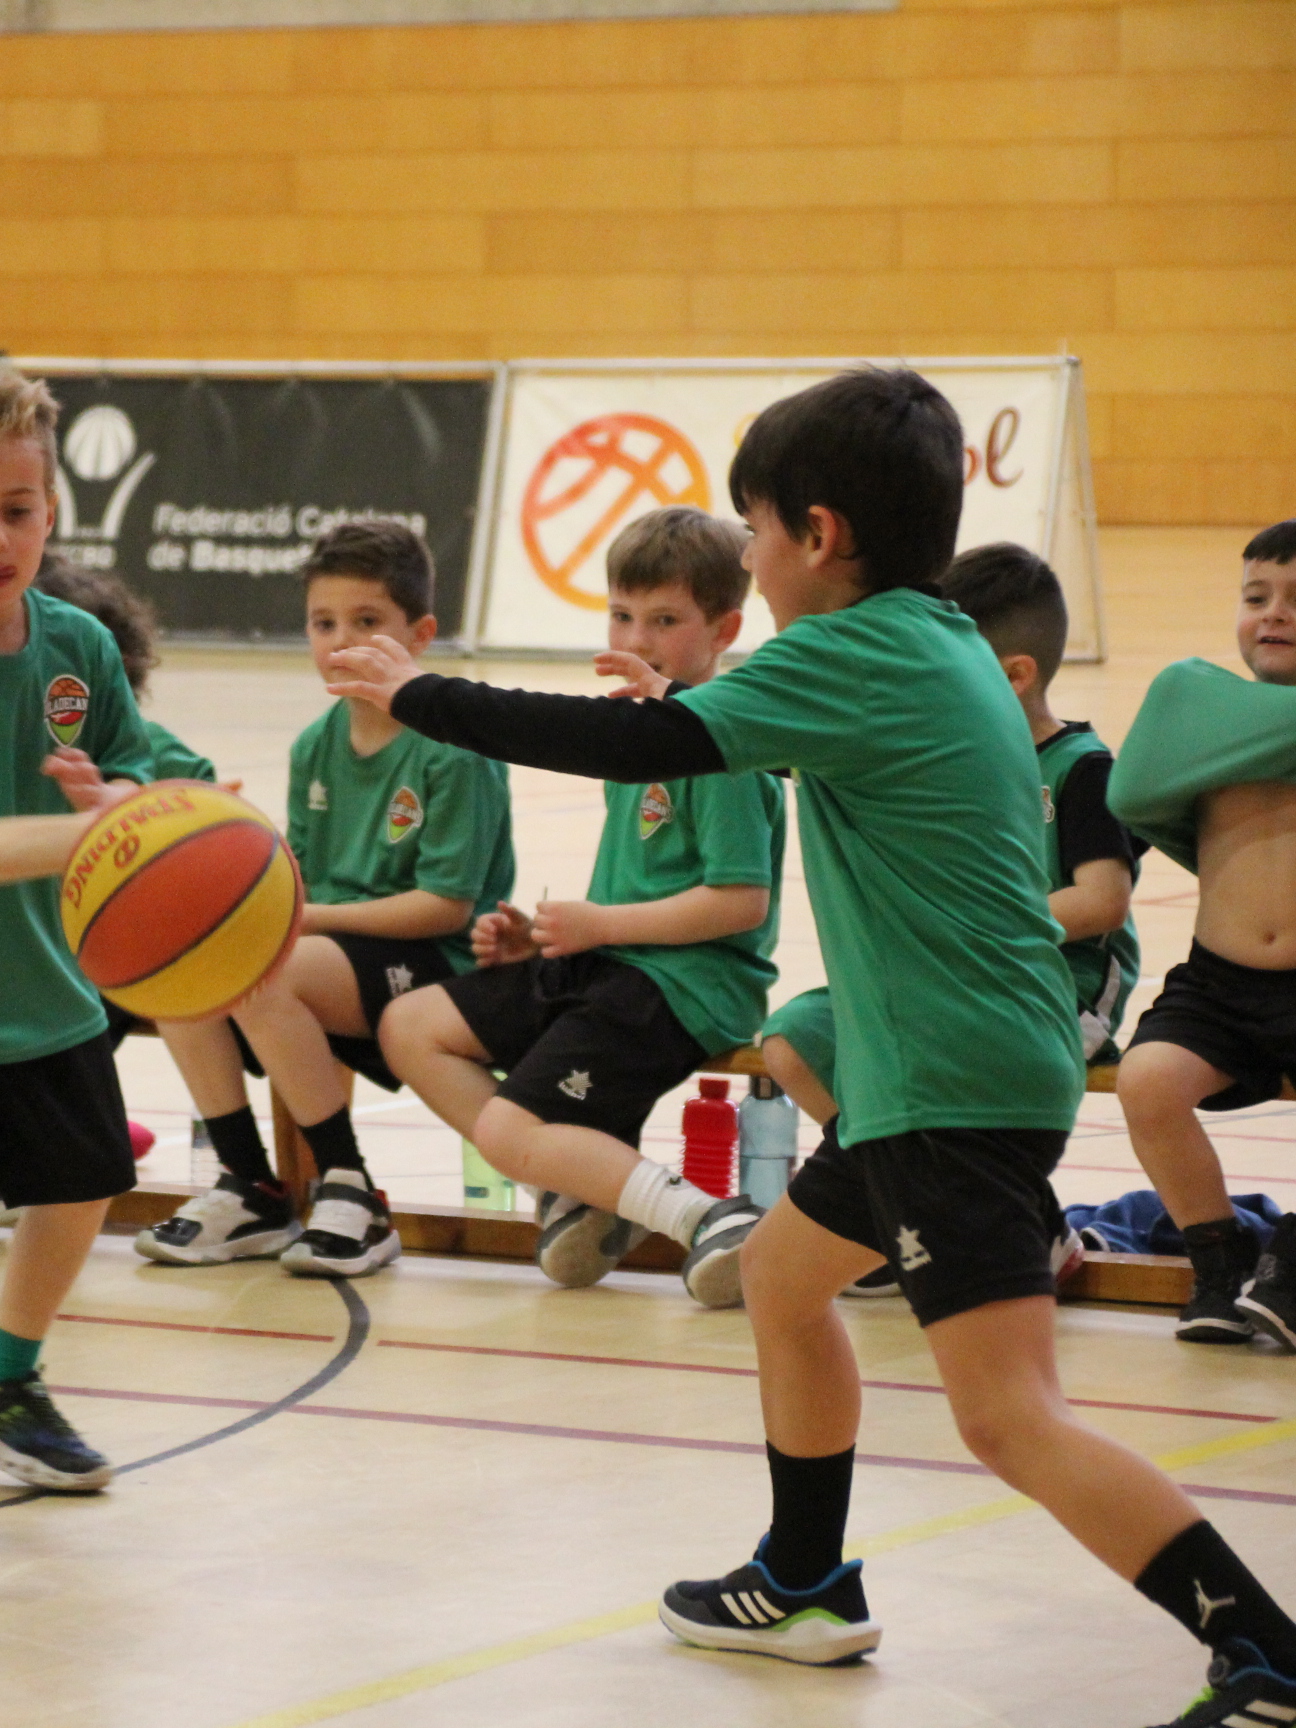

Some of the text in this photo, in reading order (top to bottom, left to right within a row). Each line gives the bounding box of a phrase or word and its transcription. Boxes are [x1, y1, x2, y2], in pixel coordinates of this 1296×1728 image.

[156, 503, 292, 537] Federació
[148, 540, 184, 571] de
[66, 788, 194, 909] SPALDING
